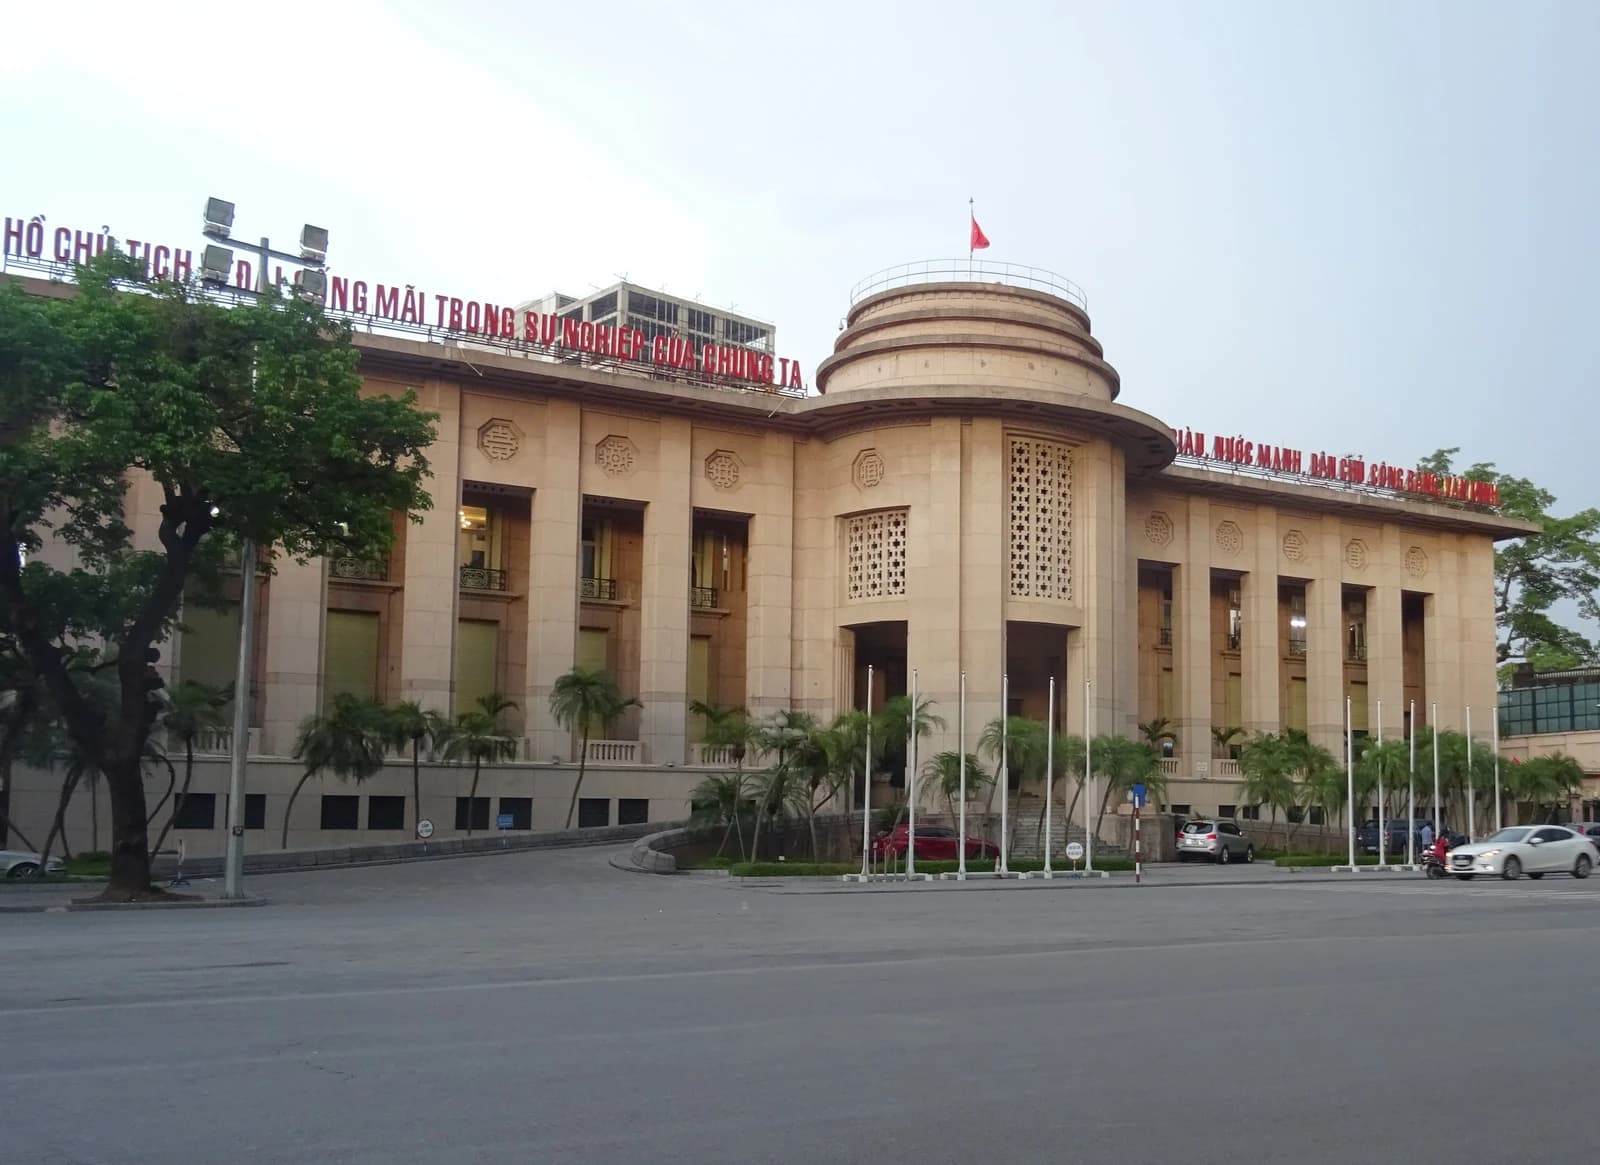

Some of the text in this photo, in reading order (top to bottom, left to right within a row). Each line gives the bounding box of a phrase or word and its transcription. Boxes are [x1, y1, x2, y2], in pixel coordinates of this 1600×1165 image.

[4, 214, 46, 257] HỒ
[236, 259, 282, 294] ĐI
[376, 283, 425, 324] MÃI
[435, 294, 515, 338] TRONG
[525, 310, 557, 350] SỰ
[561, 317, 645, 365] NGHIỆP
[703, 341, 774, 385] CHÚNG
[779, 357, 803, 389] TA
[1211, 434, 1253, 465] NƯỚC
